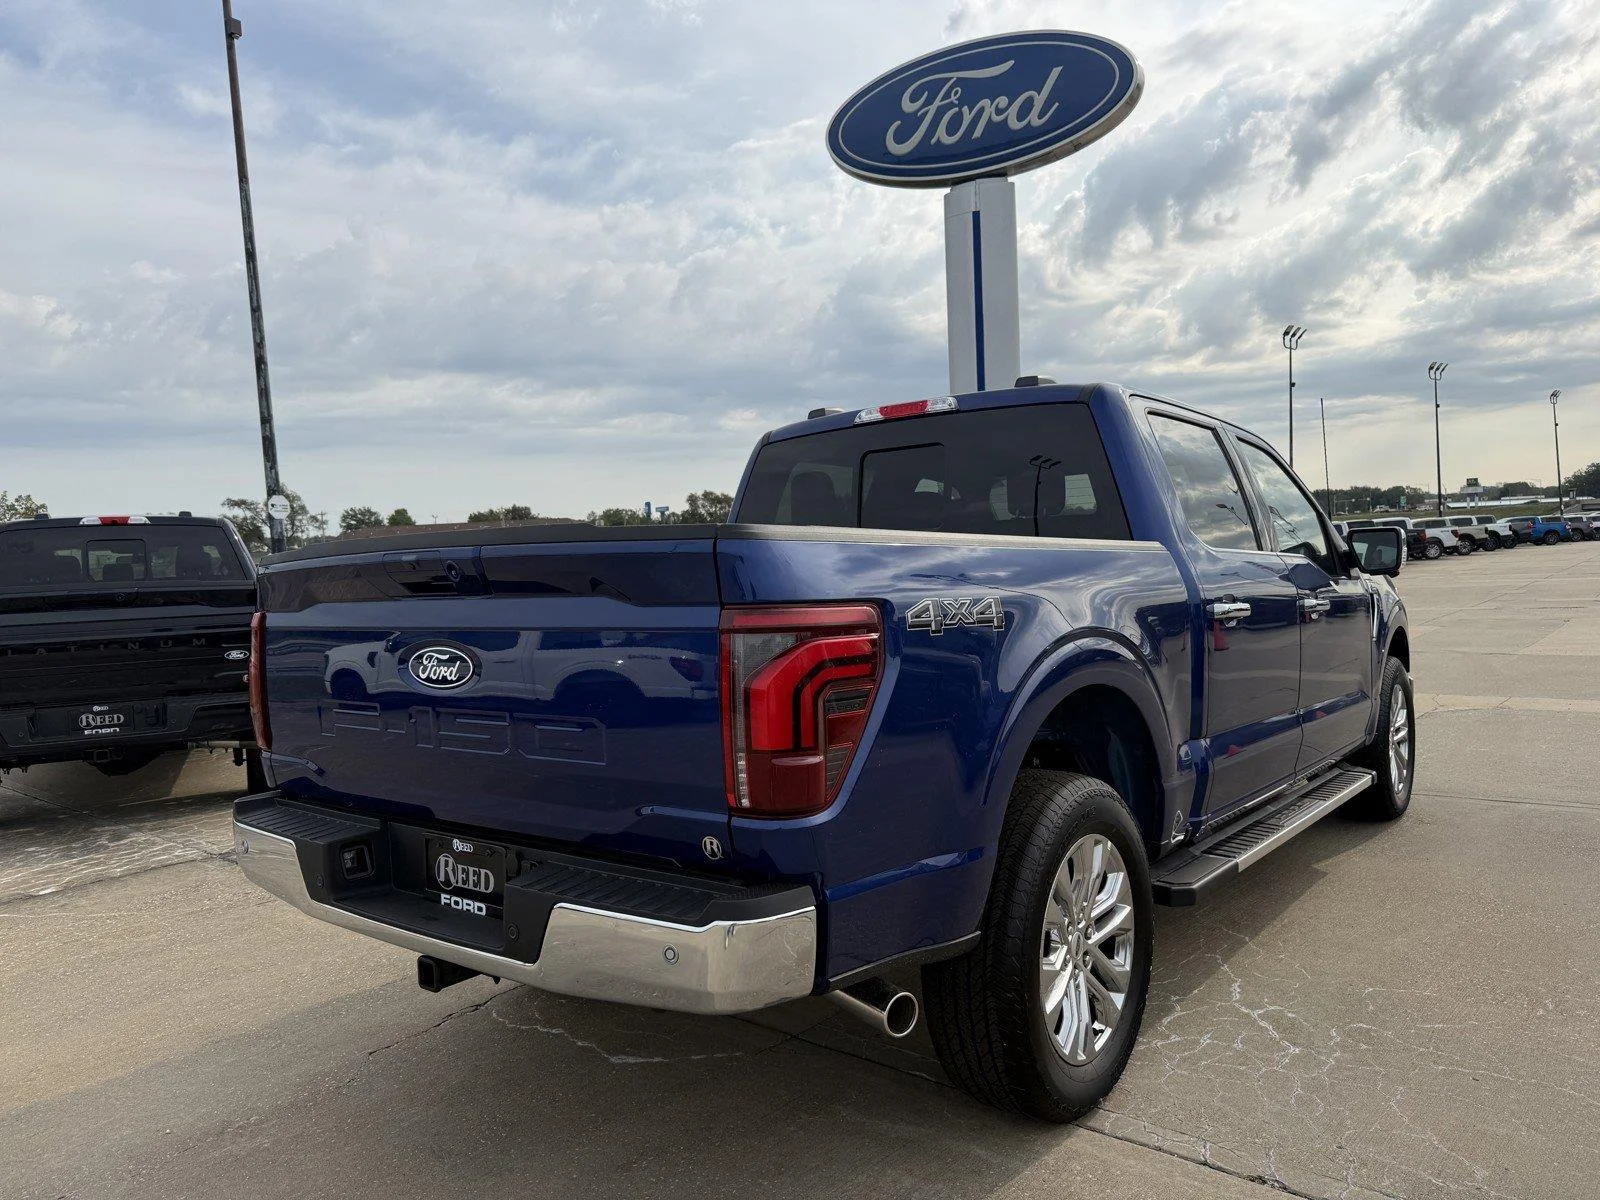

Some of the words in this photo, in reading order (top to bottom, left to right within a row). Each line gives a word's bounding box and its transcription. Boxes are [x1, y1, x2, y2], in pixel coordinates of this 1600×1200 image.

[885, 60, 1063, 157] Ford
[419, 652, 461, 681] Ford
[78, 713, 124, 728] REED
[453, 839, 473, 852] REED
[702, 836, 722, 859] R
[436, 853, 494, 893] REED
[441, 894, 486, 915] FORD
